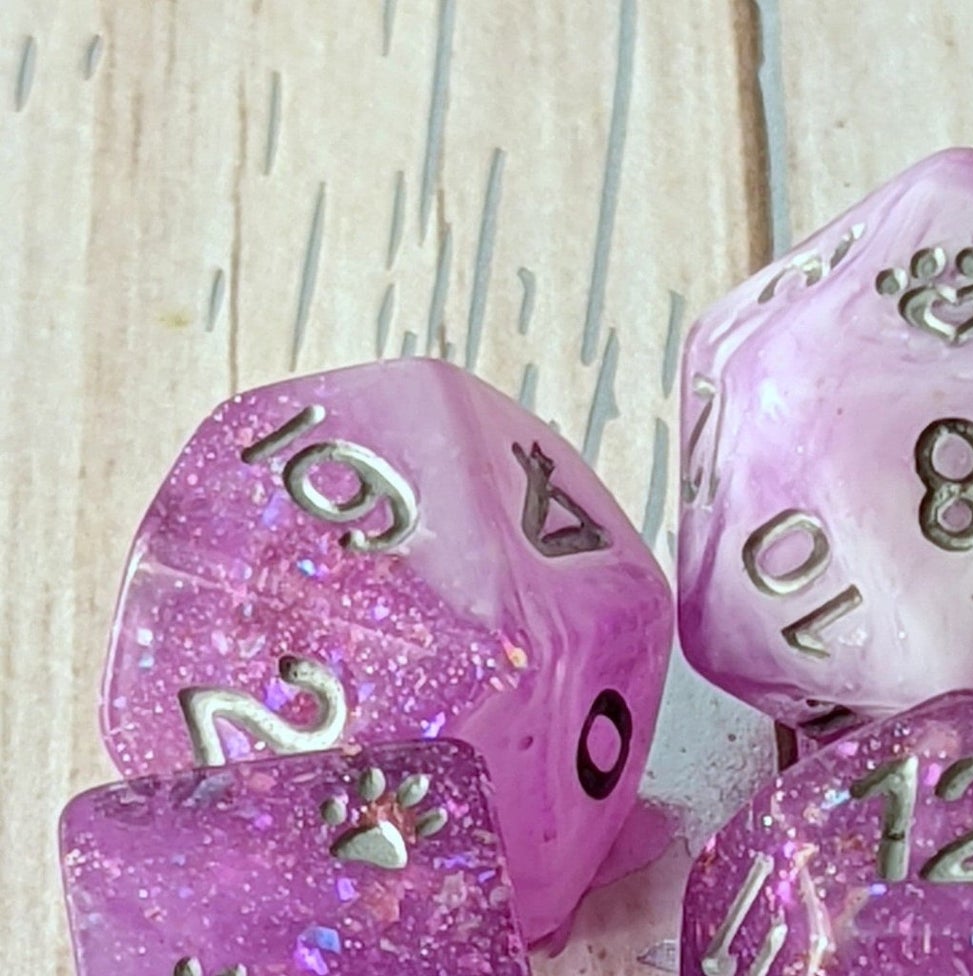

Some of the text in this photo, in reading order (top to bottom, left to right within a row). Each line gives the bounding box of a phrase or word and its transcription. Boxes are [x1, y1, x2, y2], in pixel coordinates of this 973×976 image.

[511, 440, 613, 558] 4
[741, 508, 863, 660] 10
[178, 654, 347, 767] 2
[576, 688, 632, 800] 0
